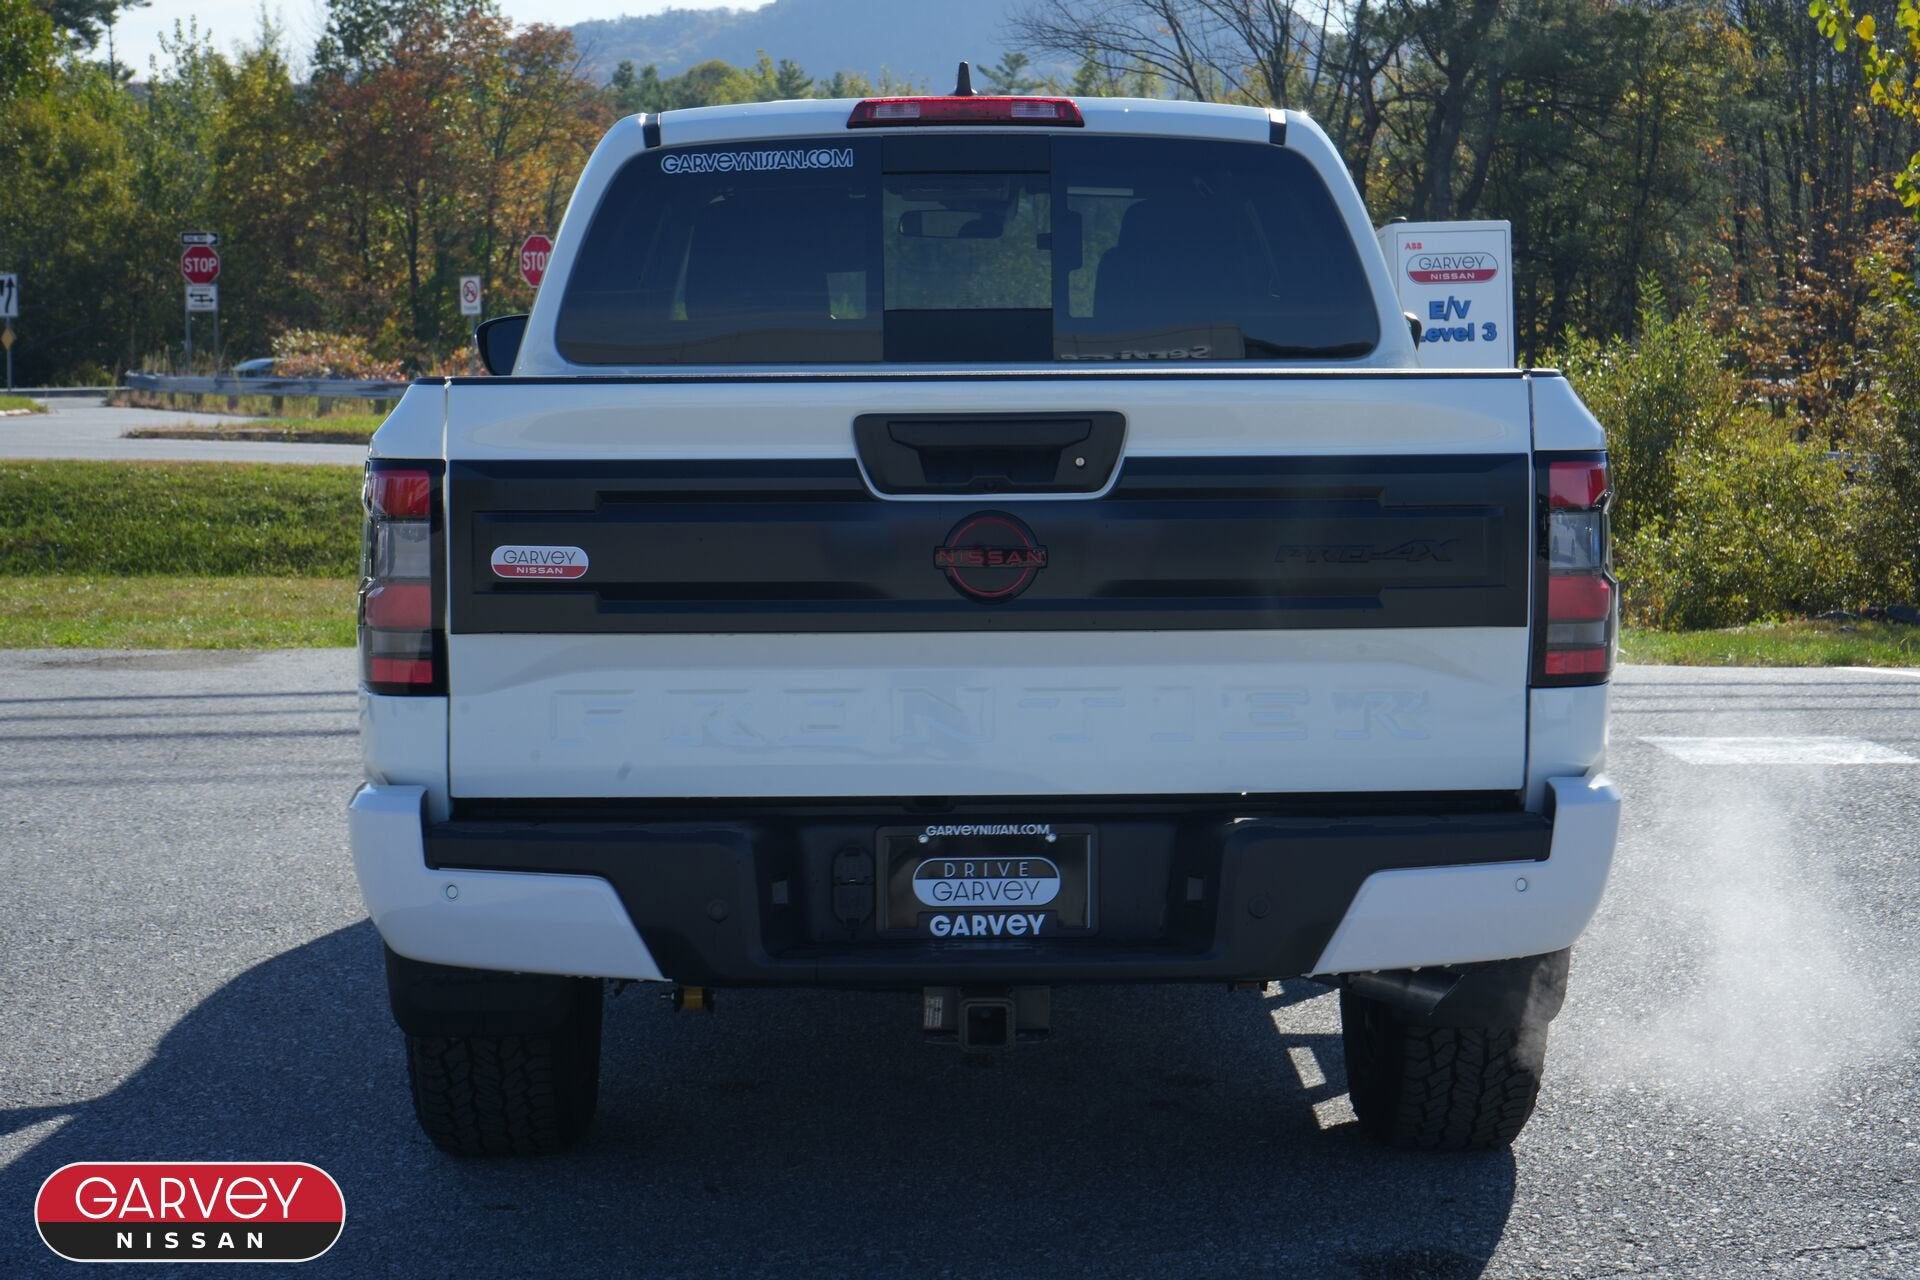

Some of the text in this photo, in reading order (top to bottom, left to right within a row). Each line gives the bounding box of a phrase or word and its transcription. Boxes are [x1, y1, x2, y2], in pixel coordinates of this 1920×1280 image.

[1404, 242, 1423, 251] ABB
[184, 257, 217, 273] STOP
[1430, 272, 1475, 281] NISSAN
[1429, 295, 1472, 321] E/V
[1481, 322, 1498, 342] 3
[936, 551, 1045, 565] NISSAN
[516, 567, 564, 575] NISSAN
[549, 685, 1432, 745] FRONTIER
[944, 862, 1029, 877] DRIVE
